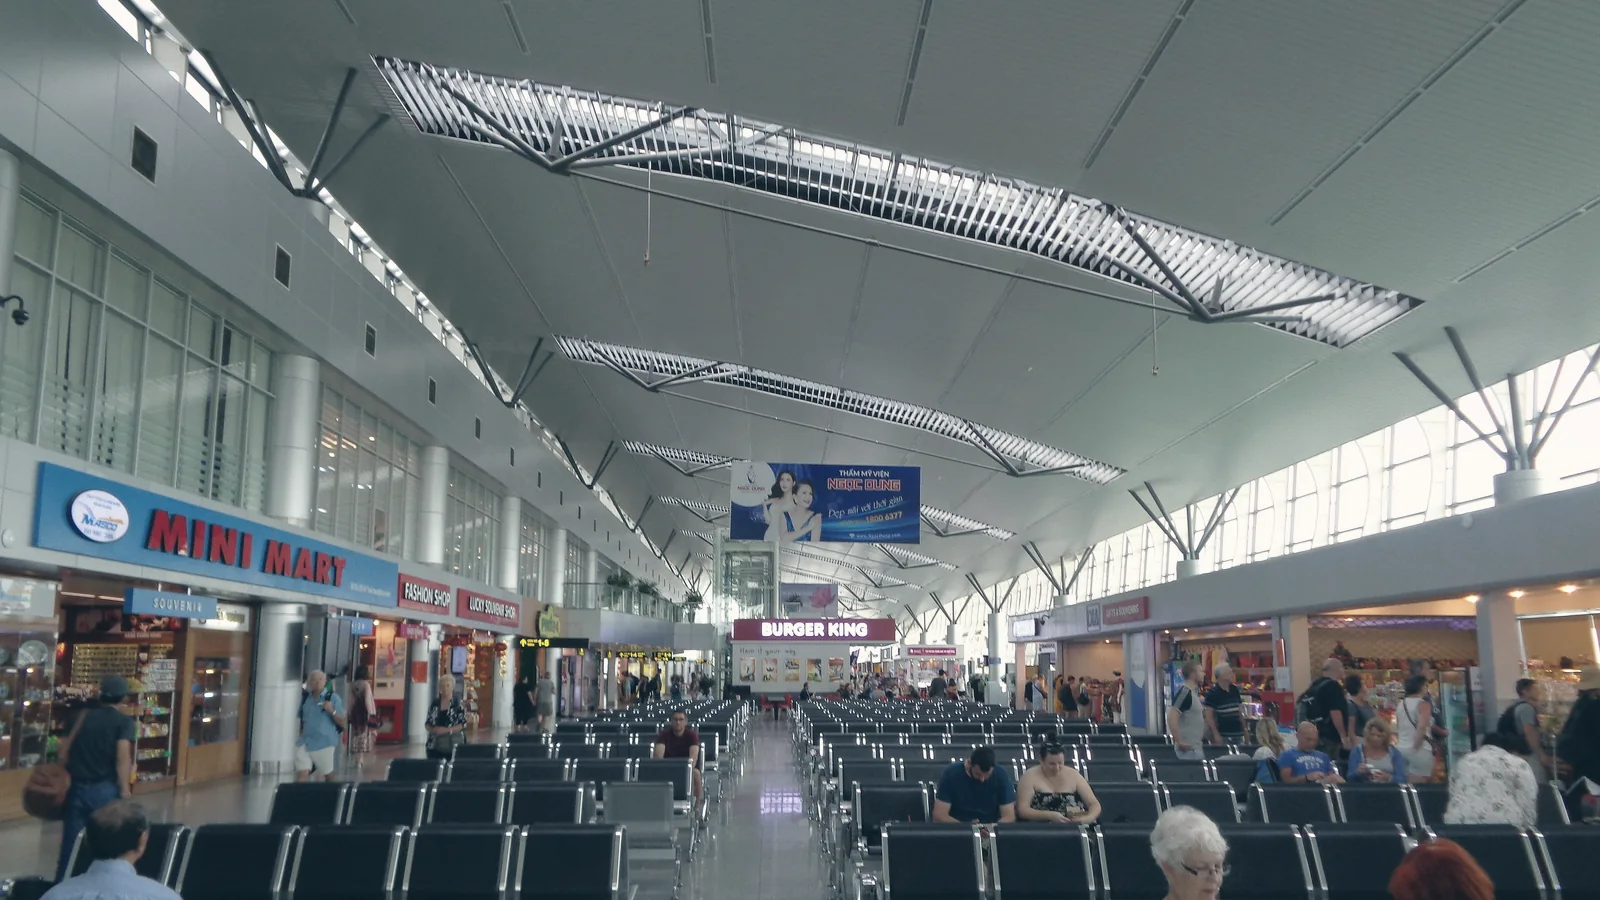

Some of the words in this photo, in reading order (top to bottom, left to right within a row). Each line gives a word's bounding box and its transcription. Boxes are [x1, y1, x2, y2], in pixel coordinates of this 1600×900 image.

[827, 478, 863, 492] NGỌC
[864, 479, 901, 491] DUNG
[148, 508, 253, 569] MINI
[264, 539, 346, 587] MART
[404, 582, 433, 604] FASHION
[434, 589, 451, 608] SHOP
[469, 596, 484, 611] LUCKY
[485, 600, 504, 616] SOUVENIR
[505, 605, 516, 618] SHOP
[761, 622, 825, 637] BURGER
[828, 622, 868, 637] KING
